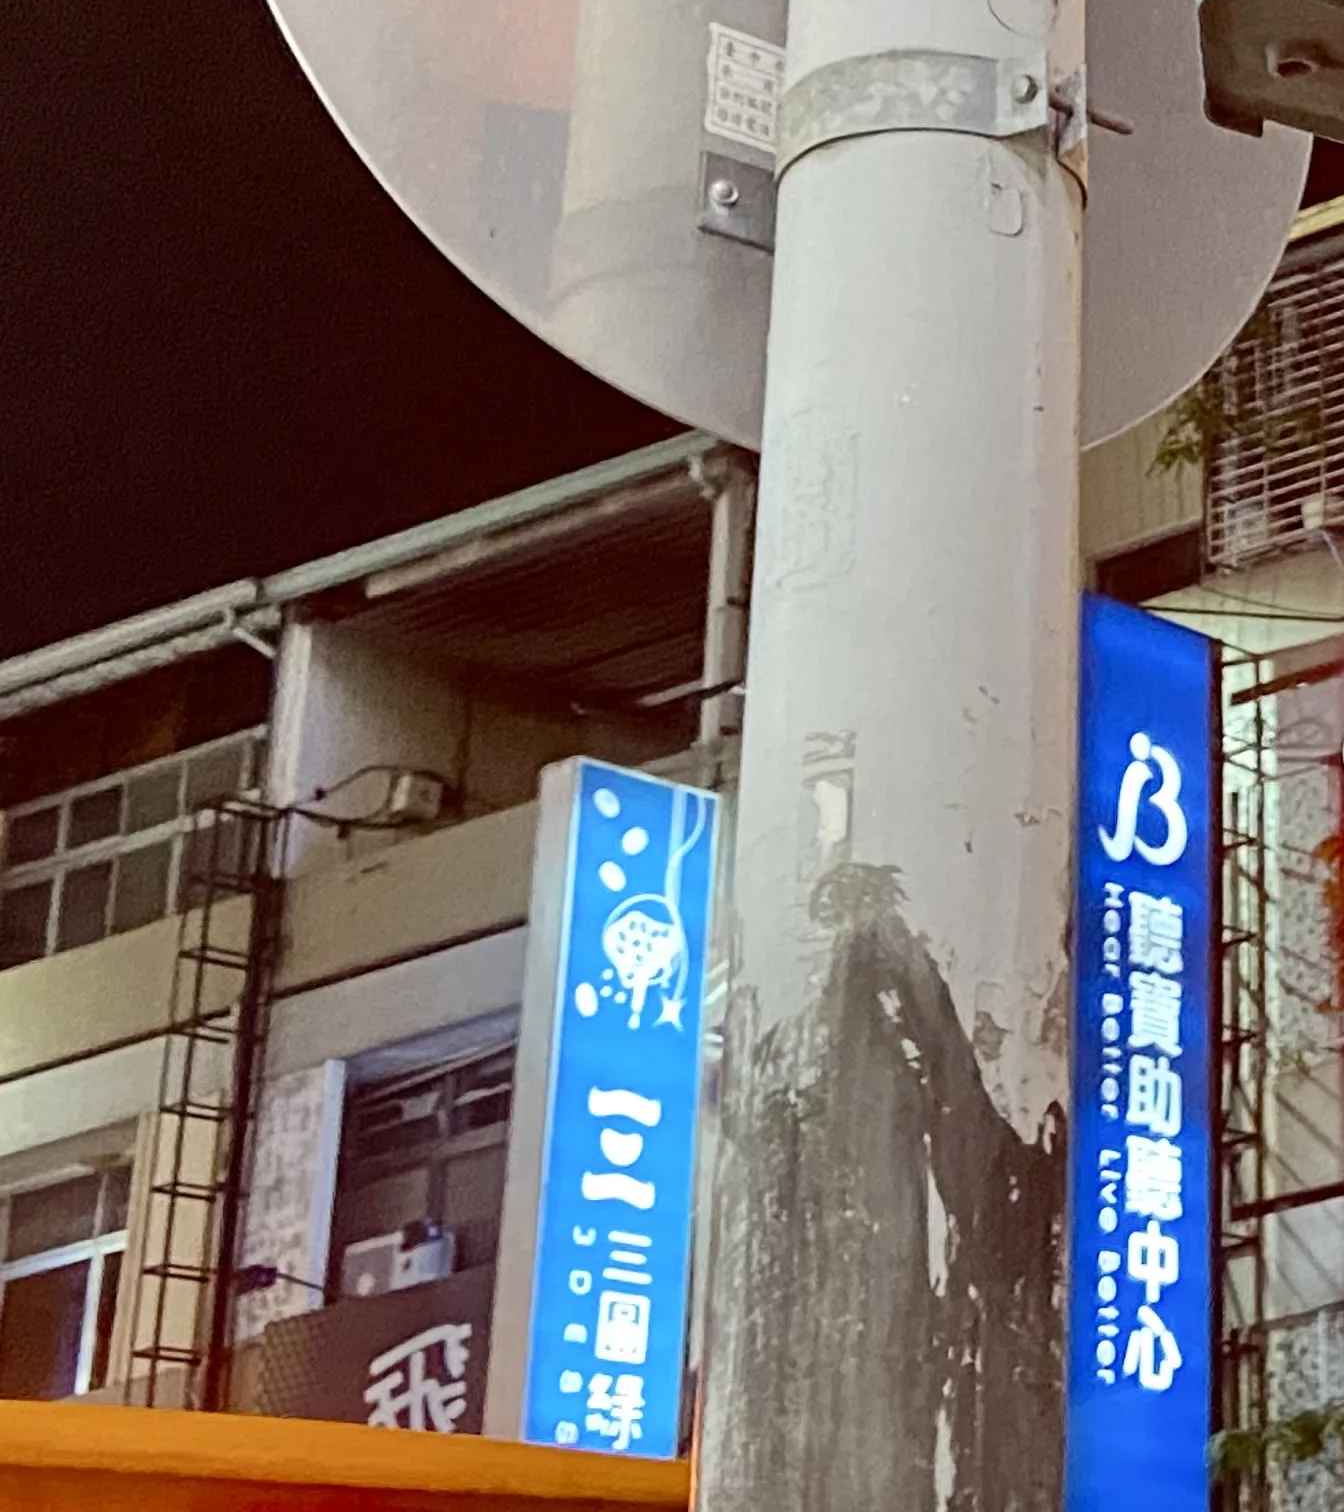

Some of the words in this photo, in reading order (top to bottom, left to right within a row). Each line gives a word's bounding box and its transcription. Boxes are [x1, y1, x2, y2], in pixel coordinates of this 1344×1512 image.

[1100, 992, 1125, 1122] Better
[1098, 1148, 1122, 1233] Live
[1096, 1250, 1121, 1385] Better
